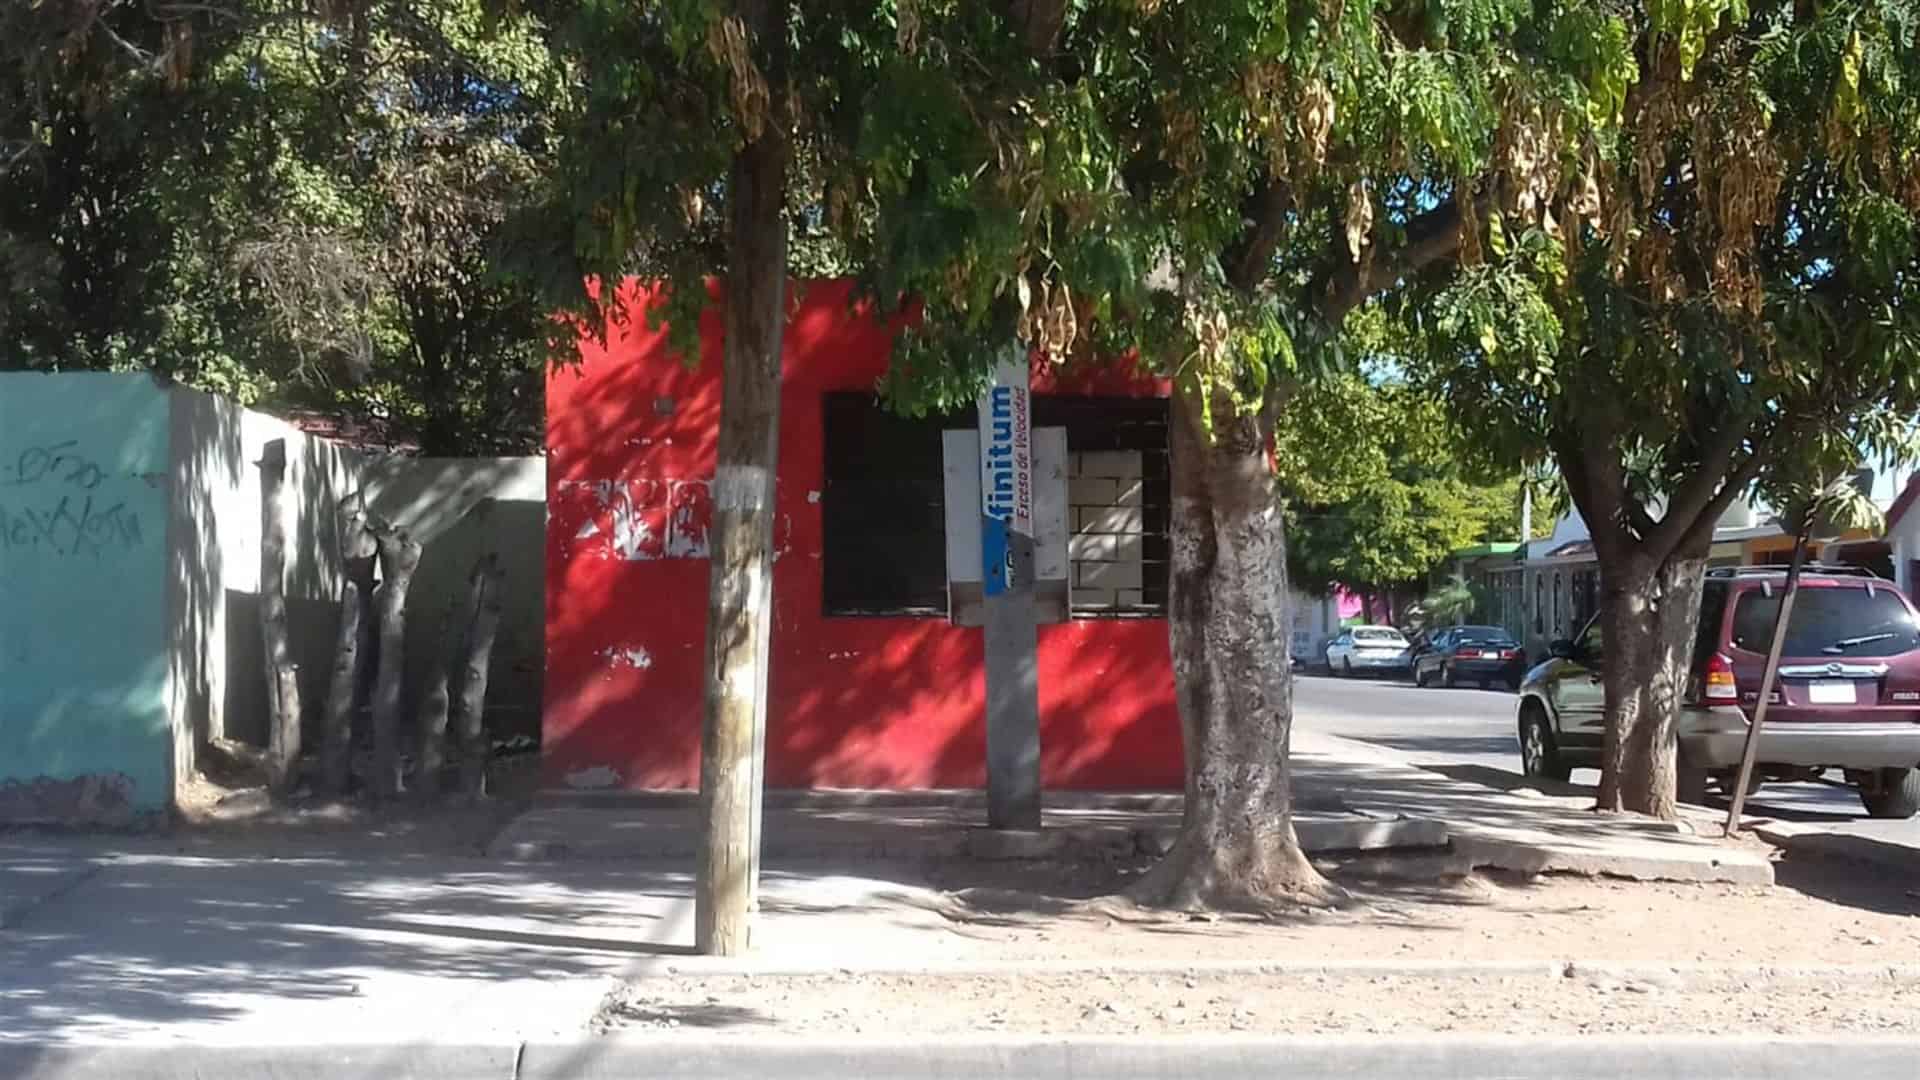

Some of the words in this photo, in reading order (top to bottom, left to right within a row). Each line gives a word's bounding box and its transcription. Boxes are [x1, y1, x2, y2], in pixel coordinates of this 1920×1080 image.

[1014, 386, 1027, 449] Velocidad
[987, 386, 1013, 517] finitum
[1016, 454, 1029, 470] de
[1016, 473, 1030, 520] Exceso
